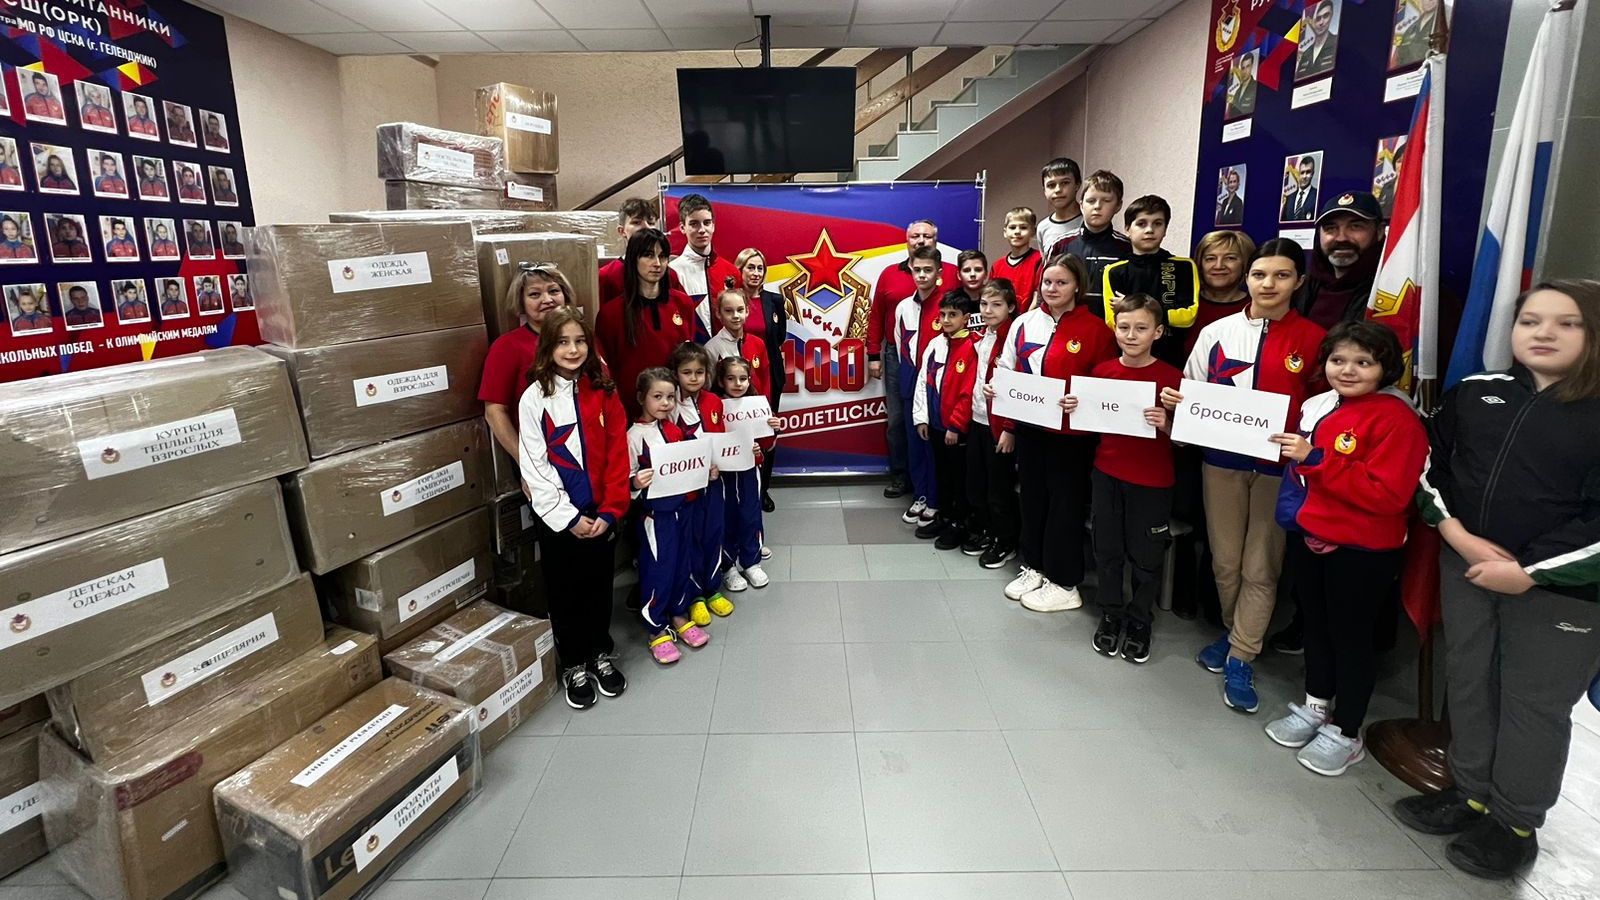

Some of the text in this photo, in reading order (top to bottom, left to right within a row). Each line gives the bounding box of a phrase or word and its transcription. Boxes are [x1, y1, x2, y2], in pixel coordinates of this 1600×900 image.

[39, 23, 55, 38] РФ
[57, 29, 85, 47] ЦСКА
[100, 42, 157, 68] ГЕЛЕНДЖИК)
[370, 267, 413, 279] ЖЕНСКАЯ
[371, 259, 409, 270] ОДЕЖДА
[802, 308, 843, 337] ЦСКА
[0, 345, 57, 364] КОЛЬНЫХ
[59, 341, 94, 356] ПОБЕД
[106, 338, 115, 349] К
[115, 329, 180, 348] ОЛИМПИЙСКИМ
[181, 324, 218, 338] МЕДАЛЯМ
[781, 338, 865, 393] 100
[387, 371, 438, 387] ОДЕЖДА ДЛЯ
[393, 380, 435, 394] ВЗРОСЛЫХ
[1008, 388, 1045, 405] Своих
[1101, 401, 1119, 412] не
[1189, 402, 1269, 429] бросаем
[143, 428, 224, 454] ТЕПЛЫЕ ДЛЯ
[156, 421, 207, 440] КУРТКИ
[151, 440, 220, 463] ВЗРОСЛЫХ
[721, 445, 740, 457] НЕ
[659, 456, 706, 477] СВОИХ
[67, 570, 135, 600] ДЕТСКАЯ
[73, 583, 136, 609] ОДЕЖДА
[10, 795, 41, 815] ОДЕ
[393, 775, 441, 821] ПРОДУКТЫ
[398, 786, 440, 827] ПИТАНИЯ
[324, 845, 356, 880] Le
